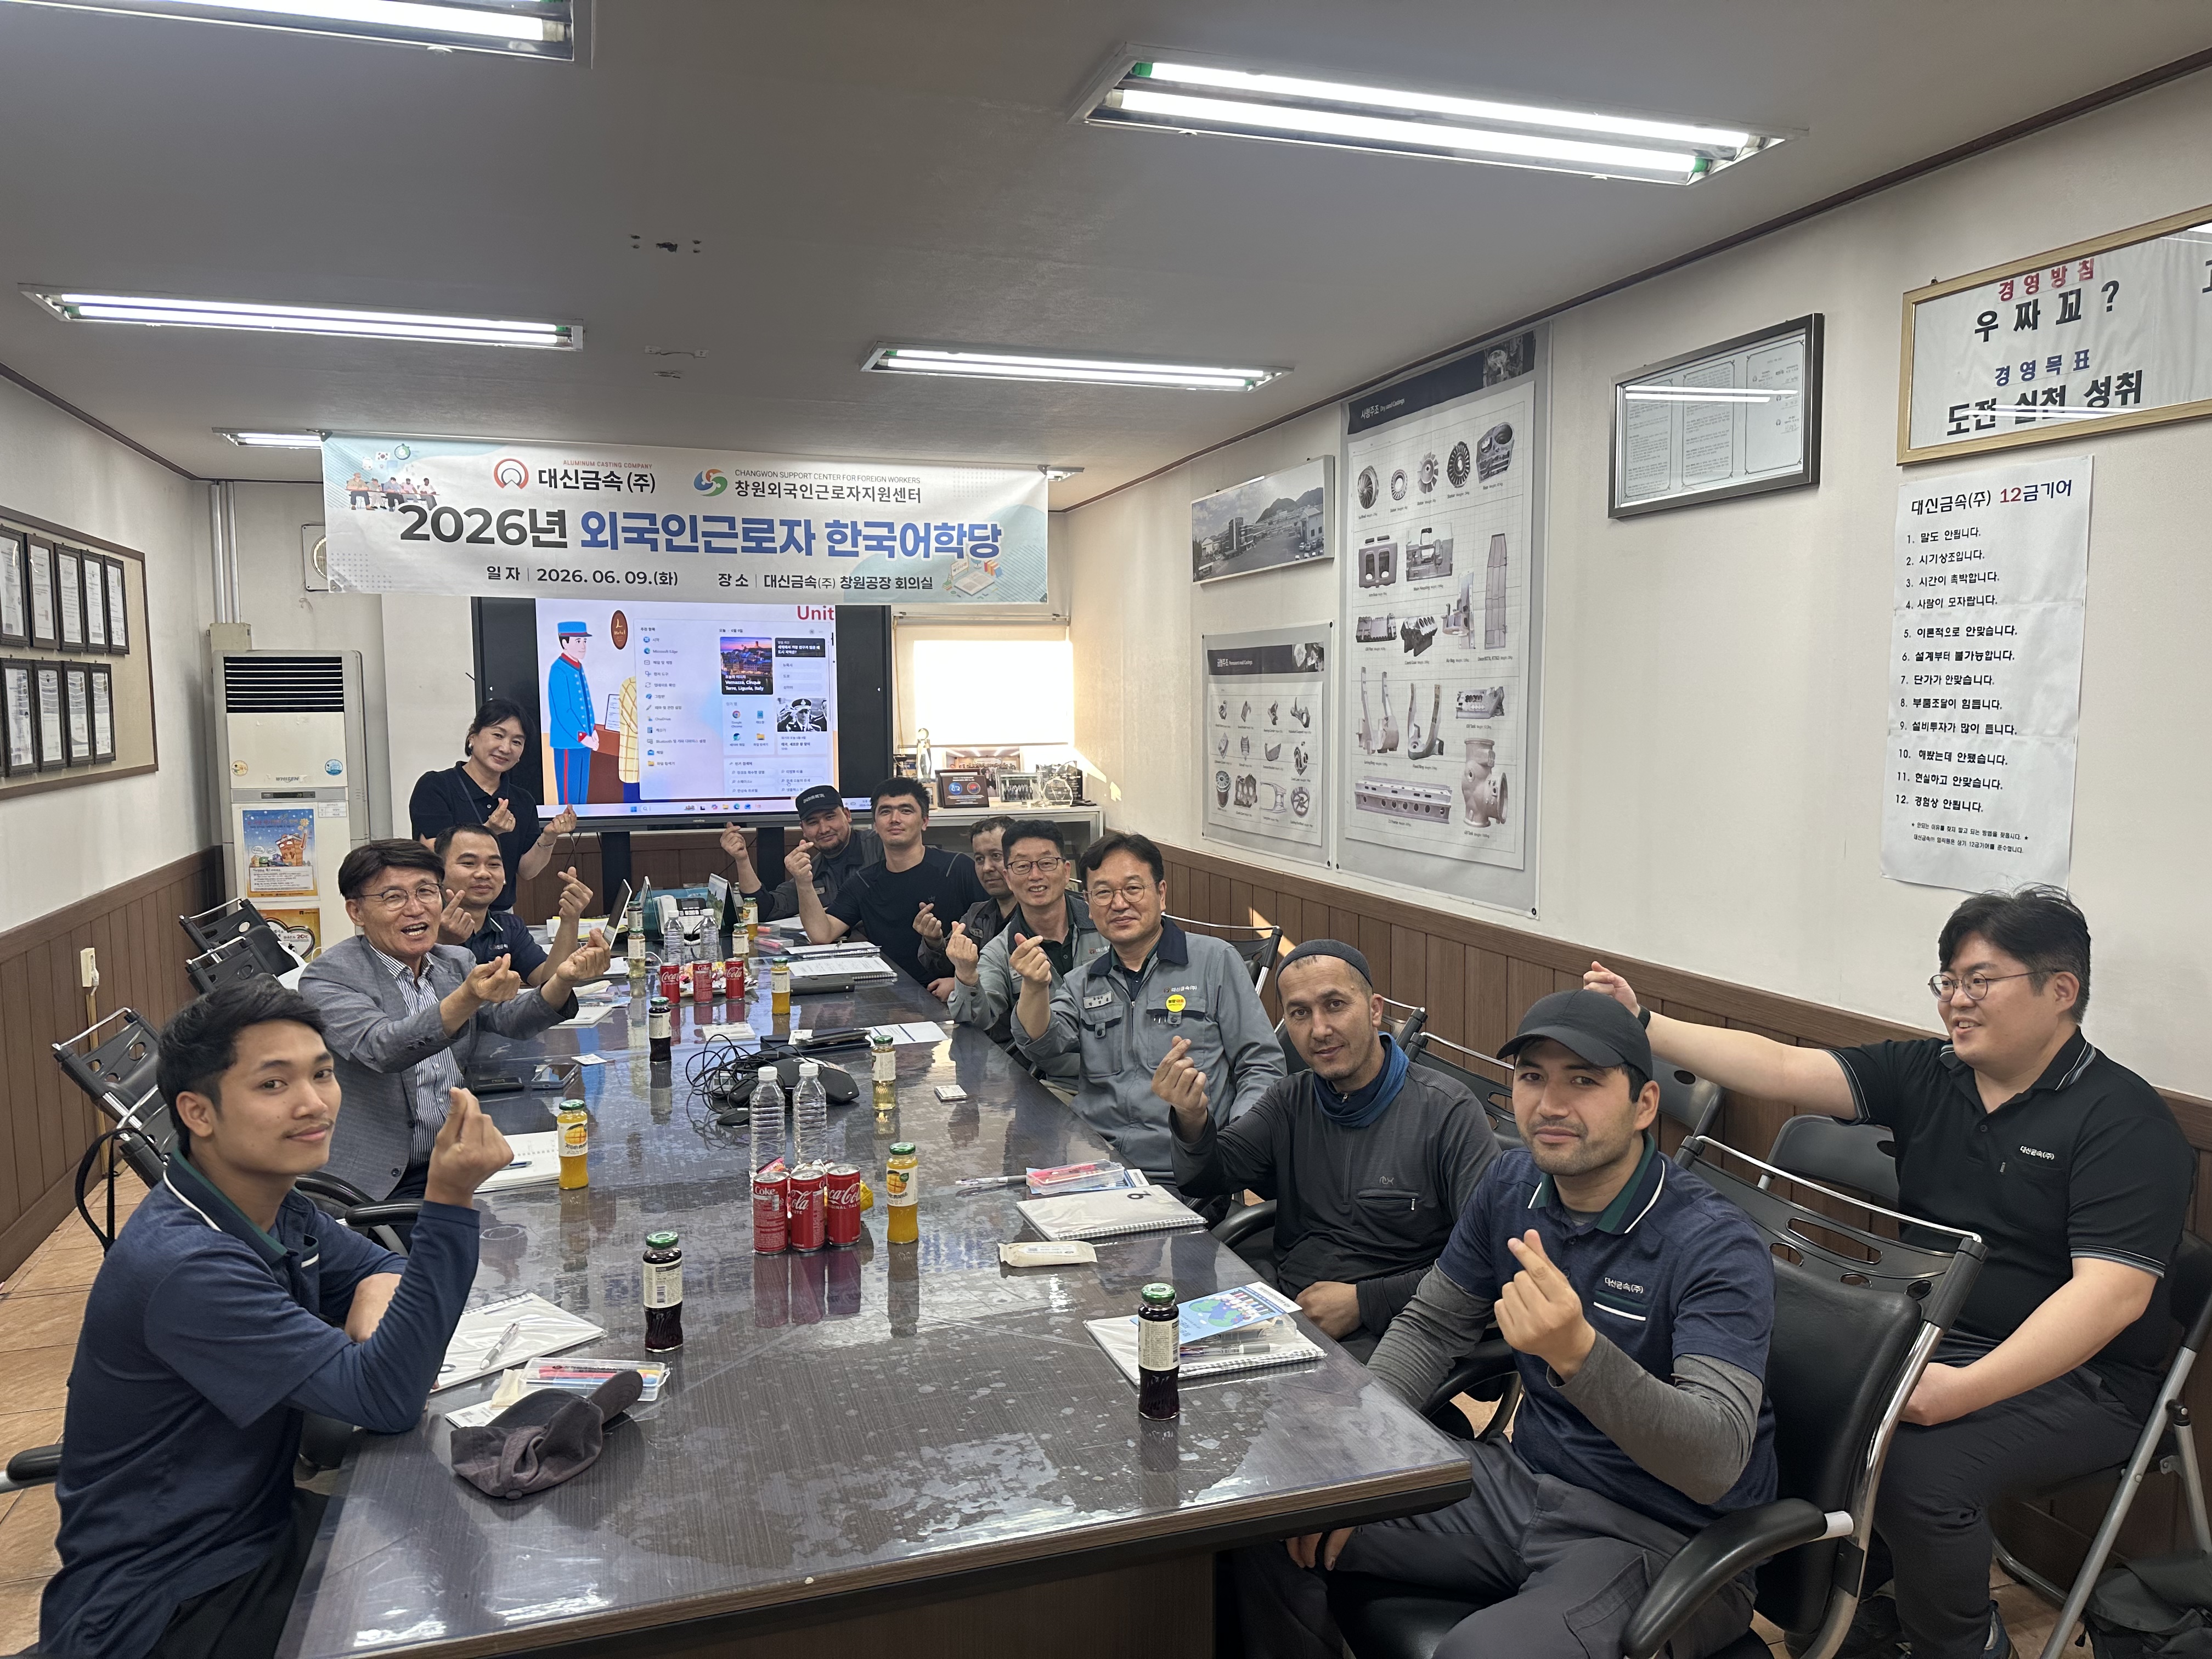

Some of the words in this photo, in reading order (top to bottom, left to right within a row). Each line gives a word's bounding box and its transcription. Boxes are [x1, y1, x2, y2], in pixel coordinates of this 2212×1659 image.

[1947, 398, 1997, 436] 도전
[2084, 370, 2142, 408] 성취
[735, 469, 778, 478] CHANGWON
[814, 472, 841, 481] CENTER
[888, 476, 920, 484] WORKERS
[735, 479, 922, 504] 창원외국인근로자지원센터
[1911, 490, 1991, 516] 대신금속(주)
[2000, 479, 2072, 504] 12금기어
[398, 504, 568, 548] 2026년
[580, 510, 815, 556] 외국인근로자
[825, 519, 1002, 559] 한국어학당
[1907, 534, 1915, 544] 1.
[1921, 531, 1939, 543] 말도
[1944, 527, 1981, 541] 안됩니다.
[1906, 557, 1914, 566] 2.
[1919, 549, 1985, 566] 시기상조입니다.
[537, 568, 588, 583] 2026.
[592, 569, 620, 584] 06.
[624, 571, 678, 587] 09.(화)
[764, 574, 836, 590] 대신금속(주)
[840, 575, 891, 590] 창원공장
[895, 576, 933, 590] 회의실
[1906, 579, 1913, 588] 3.
[1919, 575, 1946, 587] 시간이
[1950, 572, 2000, 584] 촉박합니다.
[1905, 600, 1913, 610] 4.
[1917, 597, 1943, 610] 사람이
[1948, 595, 1997, 608] 모자랍니다.
[797, 605, 834, 620] Unit
[1904, 629, 1911, 639] 5.
[1917, 627, 1960, 638] 이론적으로
[1966, 625, 2017, 637] 안맞습니다.
[1902, 652, 1910, 662] 6.
[1915, 651, 1950, 662] 설계부터
[1955, 650, 2015, 662] 불가능합니다.
[1901, 676, 1908, 685] 7.
[1914, 675, 1941, 685] 단가가
[1945, 675, 1994, 686] 안맞습니다.
[1900, 698, 1907, 707] 8.
[1913, 698, 1956, 709] 부품조달이
[1962, 698, 2002, 710] 힘듭니다.
[1900, 721, 1907, 731] 9.
[1912, 722, 1956, 733] 설비투자가
[1961, 723, 1979, 734] 많이
[1985, 725, 2017, 735] 듭니다.
[1899, 749, 1911, 759] 10.
[1918, 749, 1952, 763] 해봤는데
[1957, 752, 2007, 766] 안됐습니다.
[1897, 772, 1910, 782] 11.
[1915, 772, 1947, 786] 현실하고
[1953, 775, 2003, 791] 안맞습니다.
[1896, 794, 1908, 804] 12.
[1915, 795, 1938, 809] 경험상
[1943, 799, 1983, 813] 안됩니다.
[1982, 829, 1997, 838] 방법을
[1937, 837, 1955, 845] 임직원은
[1969, 840, 1994, 850] 12금기어를
[2020, 1146, 2055, 1160] 대신금속(주)
[754, 1186, 775, 1195] Coke
[1605, 1277, 1644, 1294] 대신금속(주)
